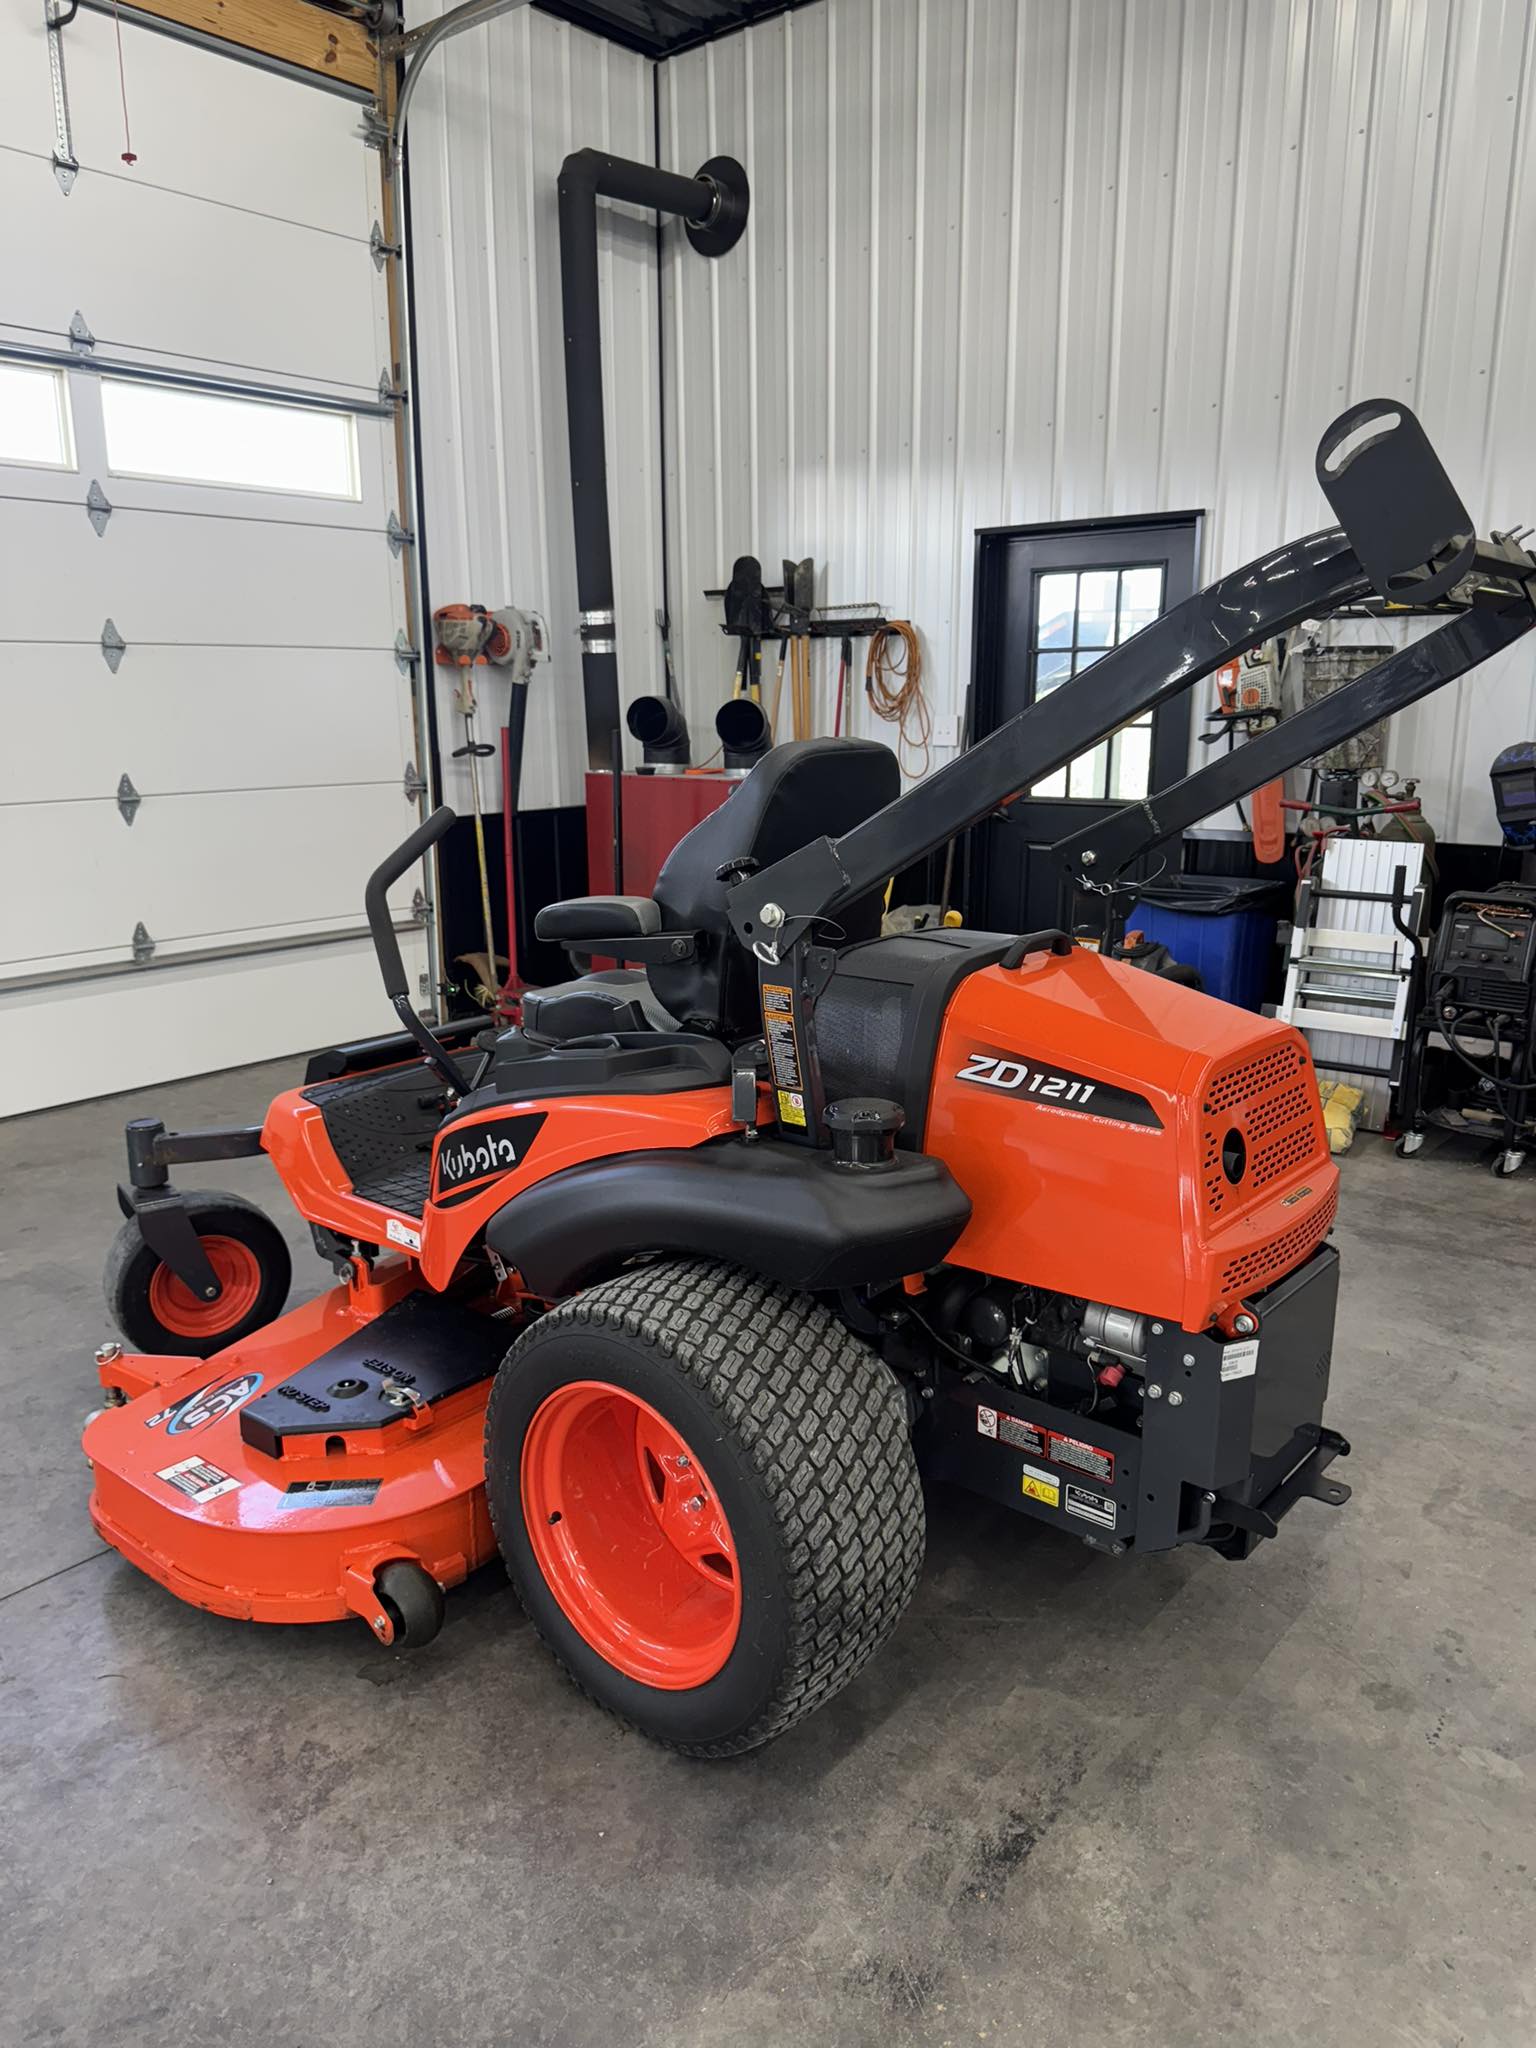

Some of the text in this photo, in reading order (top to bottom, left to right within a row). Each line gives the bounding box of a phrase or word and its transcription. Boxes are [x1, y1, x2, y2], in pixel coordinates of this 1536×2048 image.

[956, 1053, 1097, 1104] ZD 1211
[1034, 1104, 1163, 1136] Aerodynamic Cutting System
[440, 1134, 517, 1181] Kubota
[144, 1407, 178, 1429] 72
[183, 1379, 250, 1428] ACS
